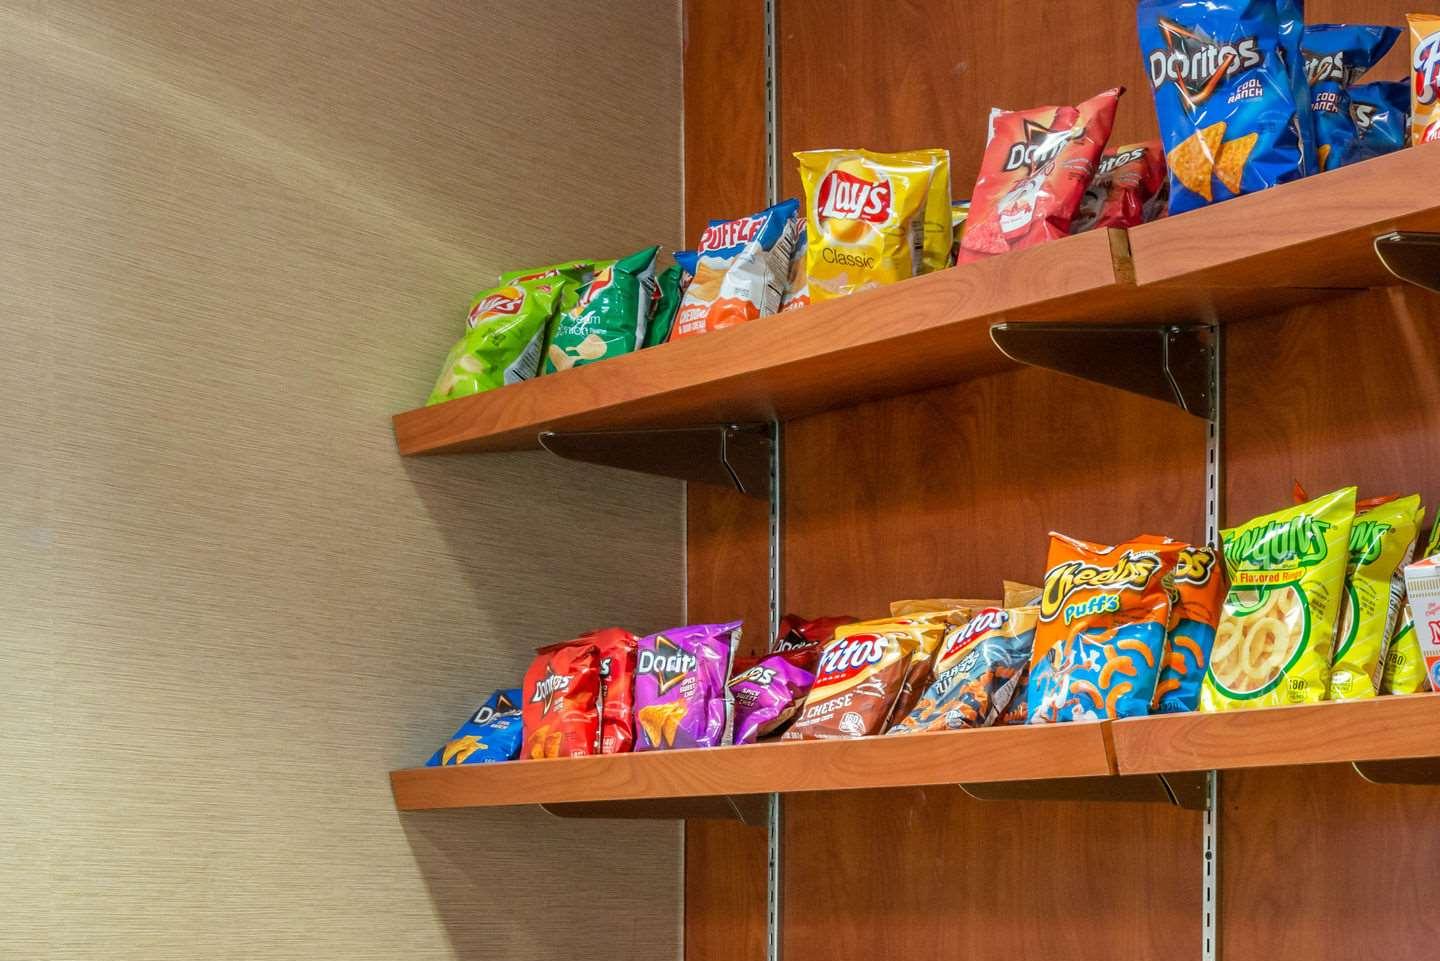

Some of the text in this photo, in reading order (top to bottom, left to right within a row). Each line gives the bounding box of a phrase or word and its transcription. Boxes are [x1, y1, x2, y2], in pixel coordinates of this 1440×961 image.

[1150, 38, 1260, 87] Doritos
[1228, 89, 1264, 104] RANCH
[1236, 79, 1261, 93] COOL
[822, 169, 889, 220] Lay's
[822, 247, 875, 269] Classic
[1042, 558, 1156, 613] Cheetos
[1240, 571, 1280, 583] Flavored
[1064, 594, 1121, 625] Puffs
[531, 674, 575, 703] Doritos
[807, 694, 853, 719] CHEESE
